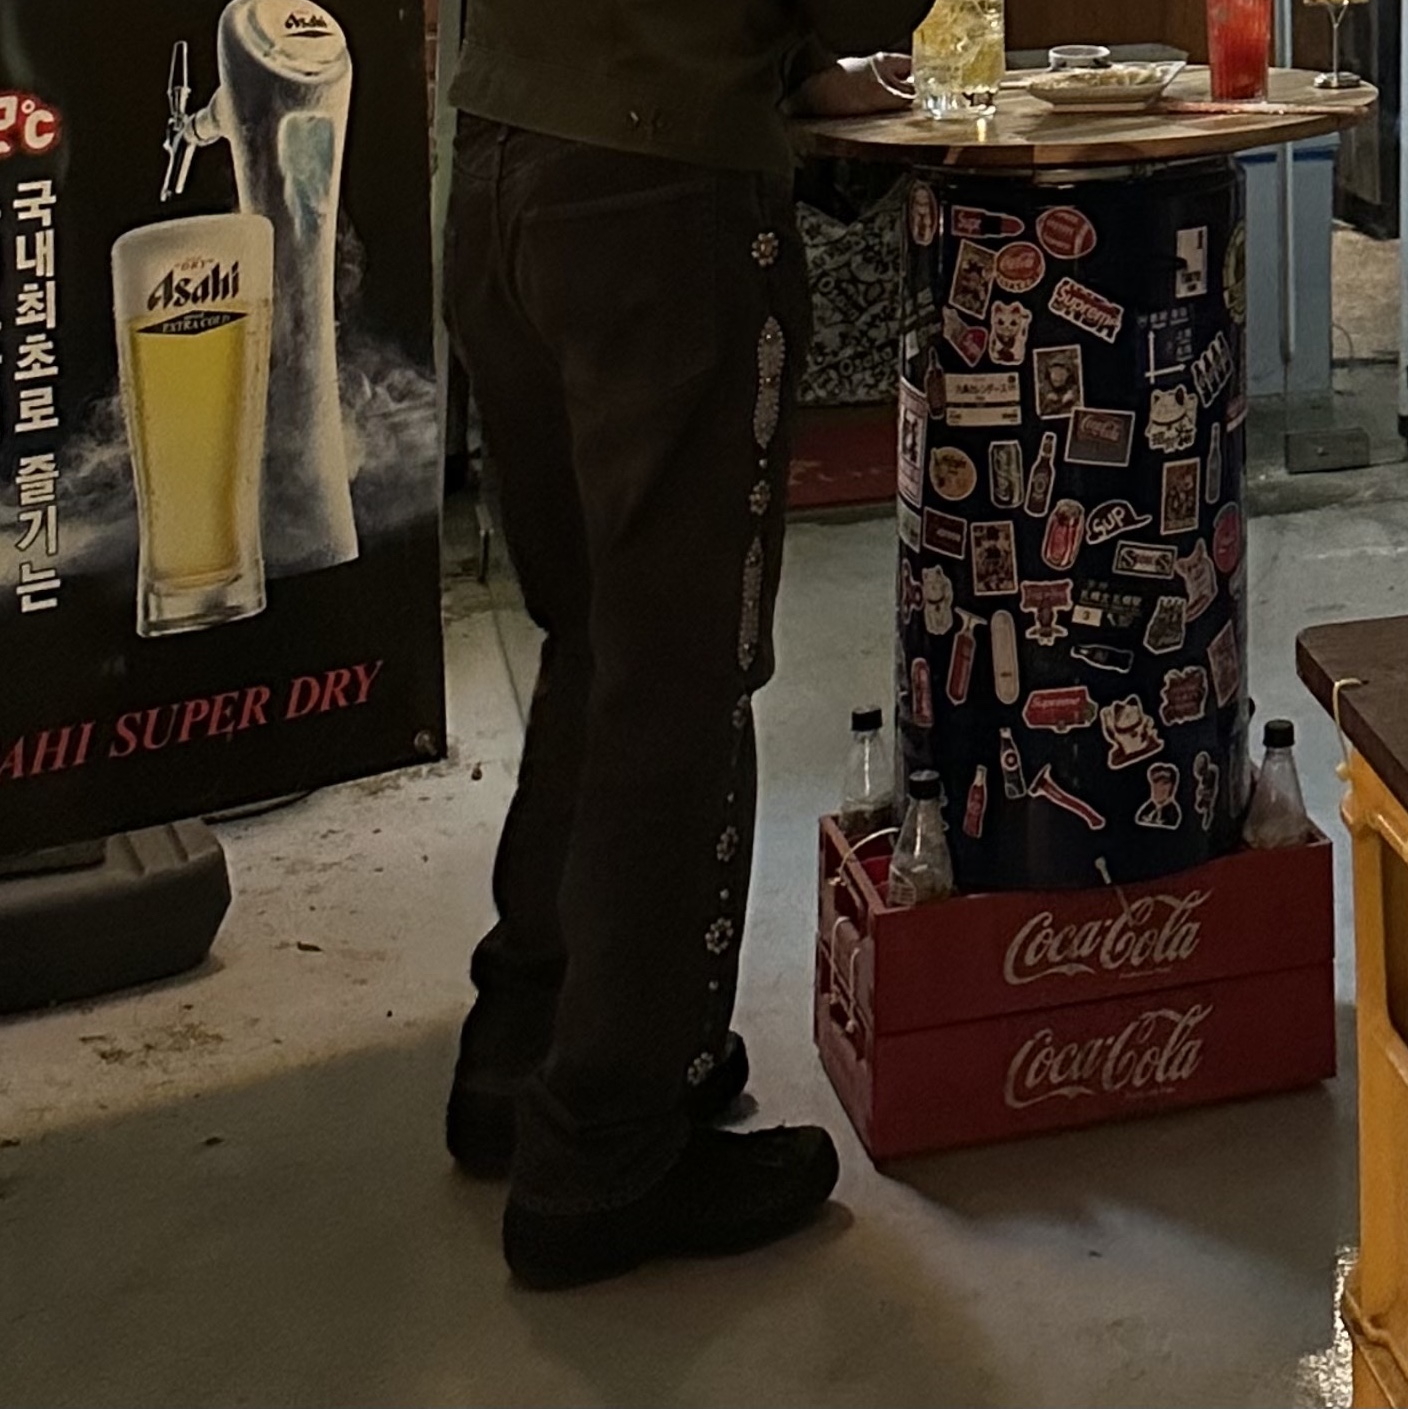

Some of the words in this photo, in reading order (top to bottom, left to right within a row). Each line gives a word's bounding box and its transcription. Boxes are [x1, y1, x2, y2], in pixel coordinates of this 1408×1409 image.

[13, 180, 59, 432] 국내최초로
[147, 260, 239, 311] Asahi
[15, 454, 61, 613] 즐기는
[1092, 506, 1126, 540] SUP
[109, 684, 271, 759] SUPER
[284, 659, 384, 720] DRY
[1004, 890, 1212, 985] Coca-Cola
[1004, 1004, 1213, 1109] Coca-Cola
